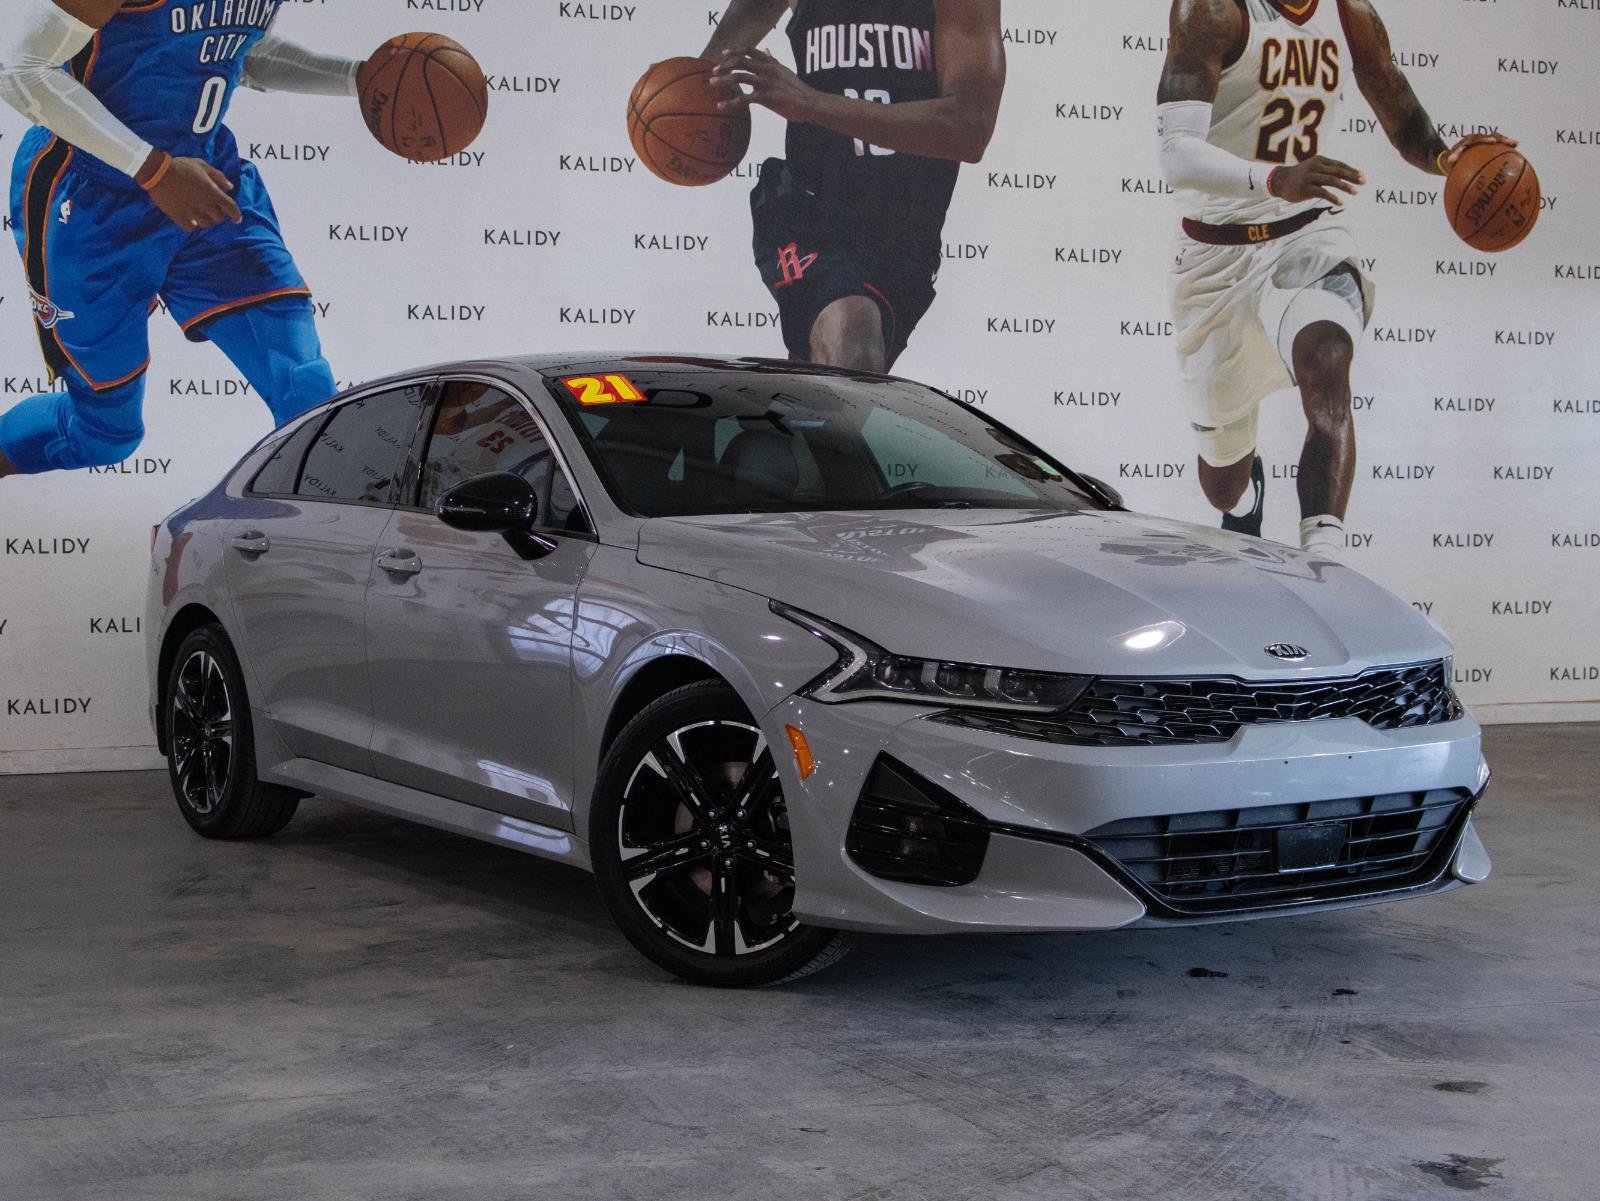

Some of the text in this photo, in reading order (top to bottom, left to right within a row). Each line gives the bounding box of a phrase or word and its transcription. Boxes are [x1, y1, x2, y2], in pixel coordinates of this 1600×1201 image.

[560, 2, 636, 21] KALIDY
[1557, 0, 1600, 11] KALI
[171, 0, 275, 33] OKLAHOM
[1002, 28, 1058, 46] ALIDY
[1122, 35, 1168, 51] KALI
[200, 34, 248, 63] CITY
[806, 23, 931, 74] HOUSTON
[1259, 38, 1339, 92] CAVS
[1391, 52, 1439, 69] ALIDY
[1498, 58, 1558, 75] KALIDY
[484, 76, 561, 94] KALIDY
[193, 76, 227, 134] 0
[1056, 104, 1123, 121] KALIDY
[1255, 97, 1326, 164] 23
[1341, 119, 1377, 134] IDY
[1556, 129, 1600, 146] KALI
[250, 143, 330, 162] KALIDY
[408, 152, 485, 167] IDY
[560, 155, 636, 173] KALIDY
[989, 173, 1056, 190] KALIDY
[1376, 189, 1437, 206] KALIDY
[329, 225, 408, 242] KALIDY
[485, 229, 561, 247] KALIDY
[1248, 225, 1269, 242] CLE
[635, 234, 709, 252] KALIDY
[941, 244, 989, 260] LIDY
[1055, 247, 1122, 264] KALIDY
[1436, 261, 1497, 276] KALIDY
[1555, 265, 1600, 280] KALID
[407, 304, 485, 321] KALIDY
[560, 307, 636, 325] KALIDY
[707, 311, 780, 328] KALIDY
[988, 317, 1056, 334] KALIDY
[1121, 321, 1173, 337] KALID
[1374, 328, 1436, 343] KALIDY
[1495, 331, 1555, 346] KALIDY
[5, 378, 69, 394] KALI
[170, 379, 249, 396] KALIDY
[567, 375, 643, 404] 21
[946, 390, 988, 405] IDY
[1054, 392, 1121, 407] KALIDY
[1435, 398, 1495, 412] KALIDY
[1553, 400, 1600, 414] KALID
[887, 464, 918, 478] IDY
[1120, 463, 1185, 478] KALIDY
[1273, 465, 1298, 479] LID
[1373, 466, 1434, 480] KALIDY
[1494, 466, 1554, 480] KALIDY
[6, 538, 90, 555] KALIDY
[1344, 534, 1373, 548] IDY
[1433, 534, 1494, 548] KALIDY
[1552, 534, 1600, 548] KALID
[1492, 601, 1552, 615] KALIDY
[90, 617, 140, 634] KALI
[1268, 644, 1307, 657] KIA
[1455, 669, 1493, 683] LIDY
[1550, 667, 1600, 681] KALID
[8, 698, 92, 716] KALIDY
